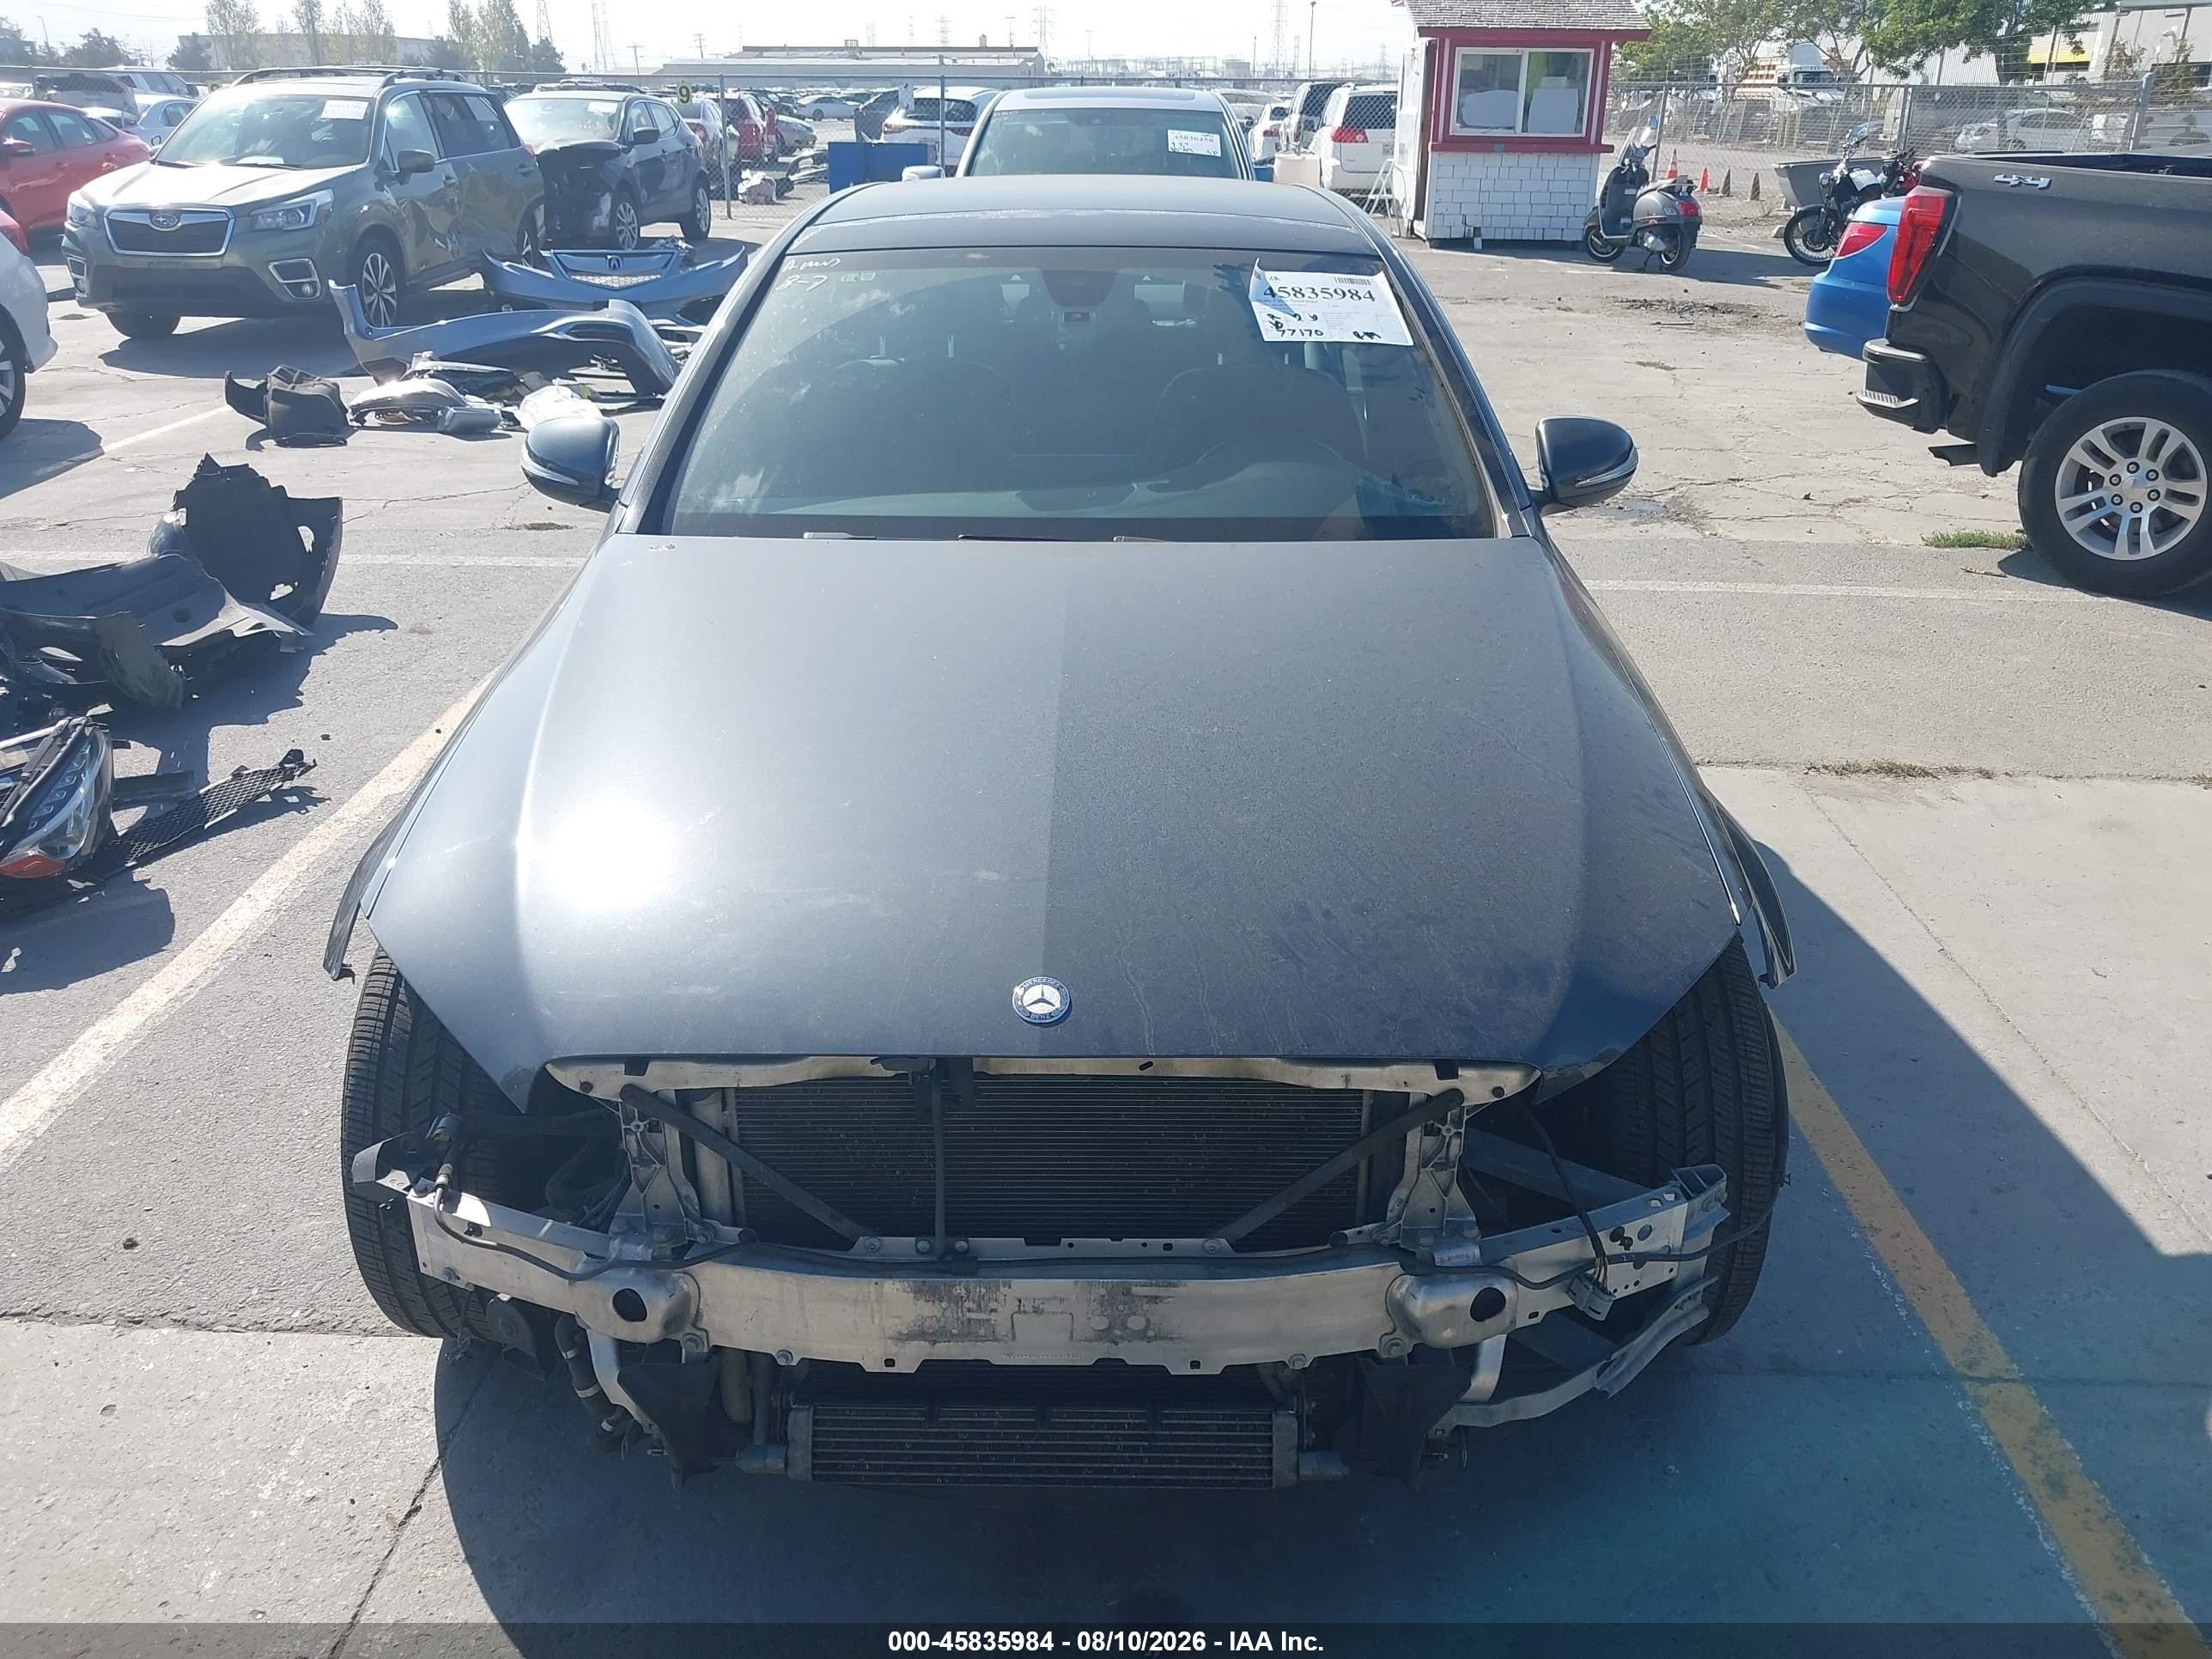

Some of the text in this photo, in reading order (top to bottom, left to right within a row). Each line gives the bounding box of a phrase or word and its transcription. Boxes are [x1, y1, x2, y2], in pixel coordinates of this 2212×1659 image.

[678, 85, 690, 104] 9
[1263, 286, 1376, 302] 45835984
[1030, 1012, 1052, 1021] BENZ
